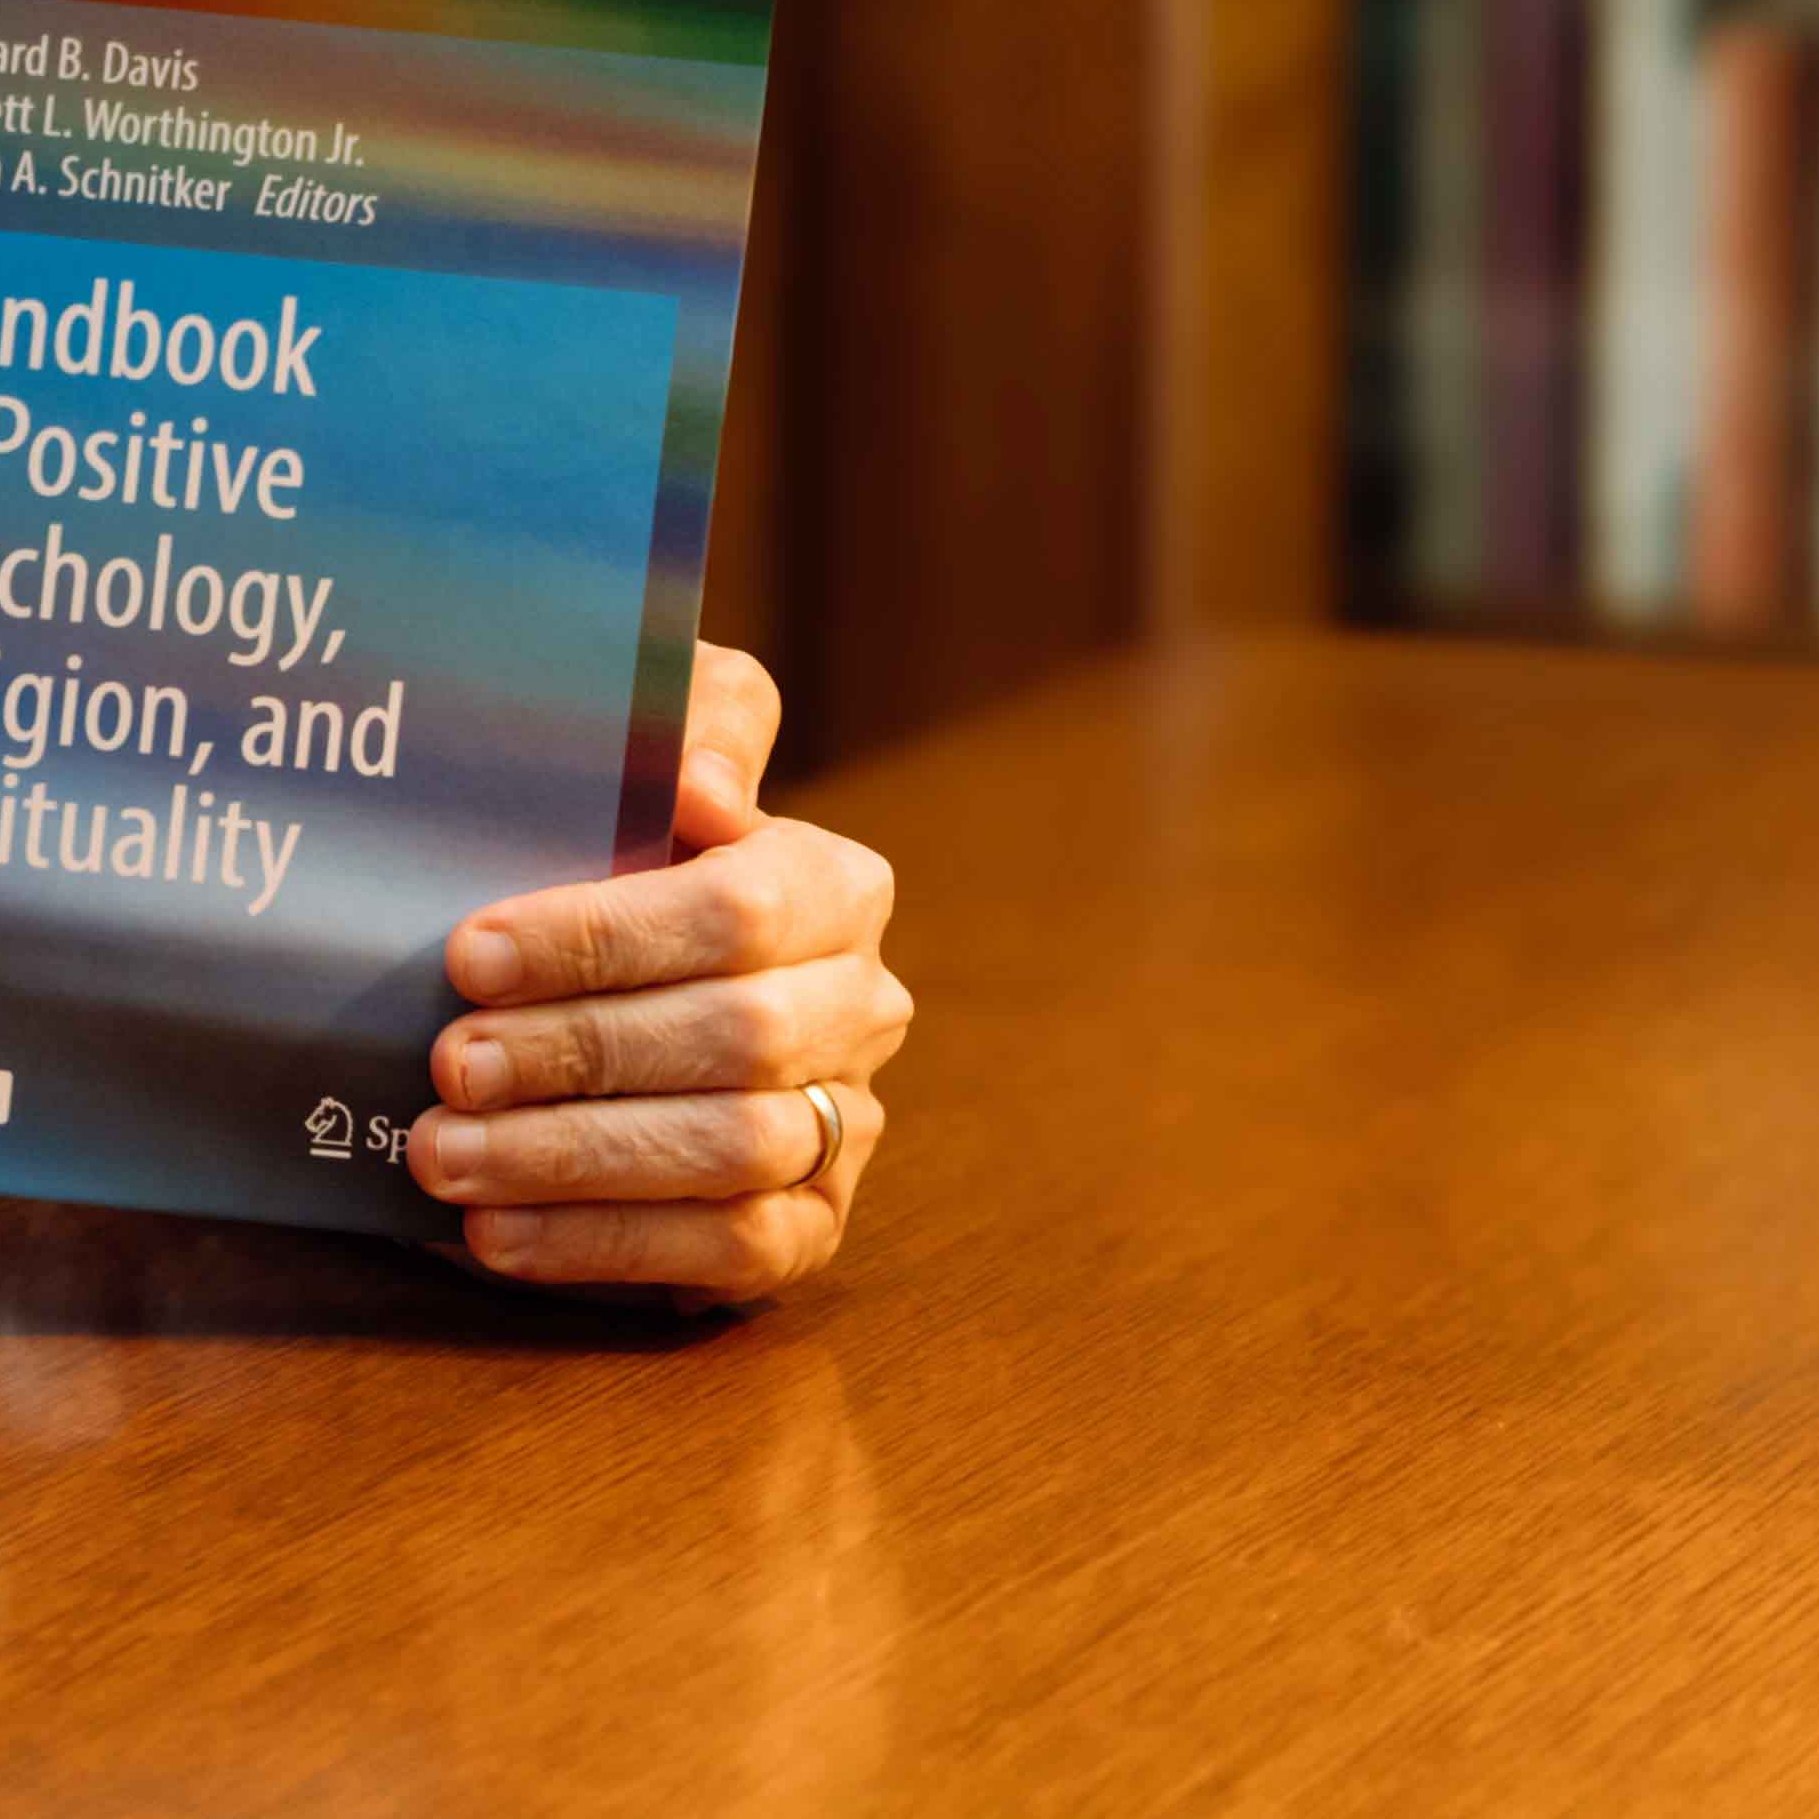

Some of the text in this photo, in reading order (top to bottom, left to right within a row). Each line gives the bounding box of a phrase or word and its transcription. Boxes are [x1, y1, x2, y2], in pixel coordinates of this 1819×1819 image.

[57, 37, 90, 81] B.
[102, 43, 199, 92] Davis
[42, 97, 72, 138] L.
[84, 98, 317, 166] Worthington
[325, 124, 364, 167] Jr.
[10, 151, 48, 196] A.
[57, 155, 233, 212] Schnitker
[254, 174, 379, 226] Editors
[240, 680, 405, 778] and
